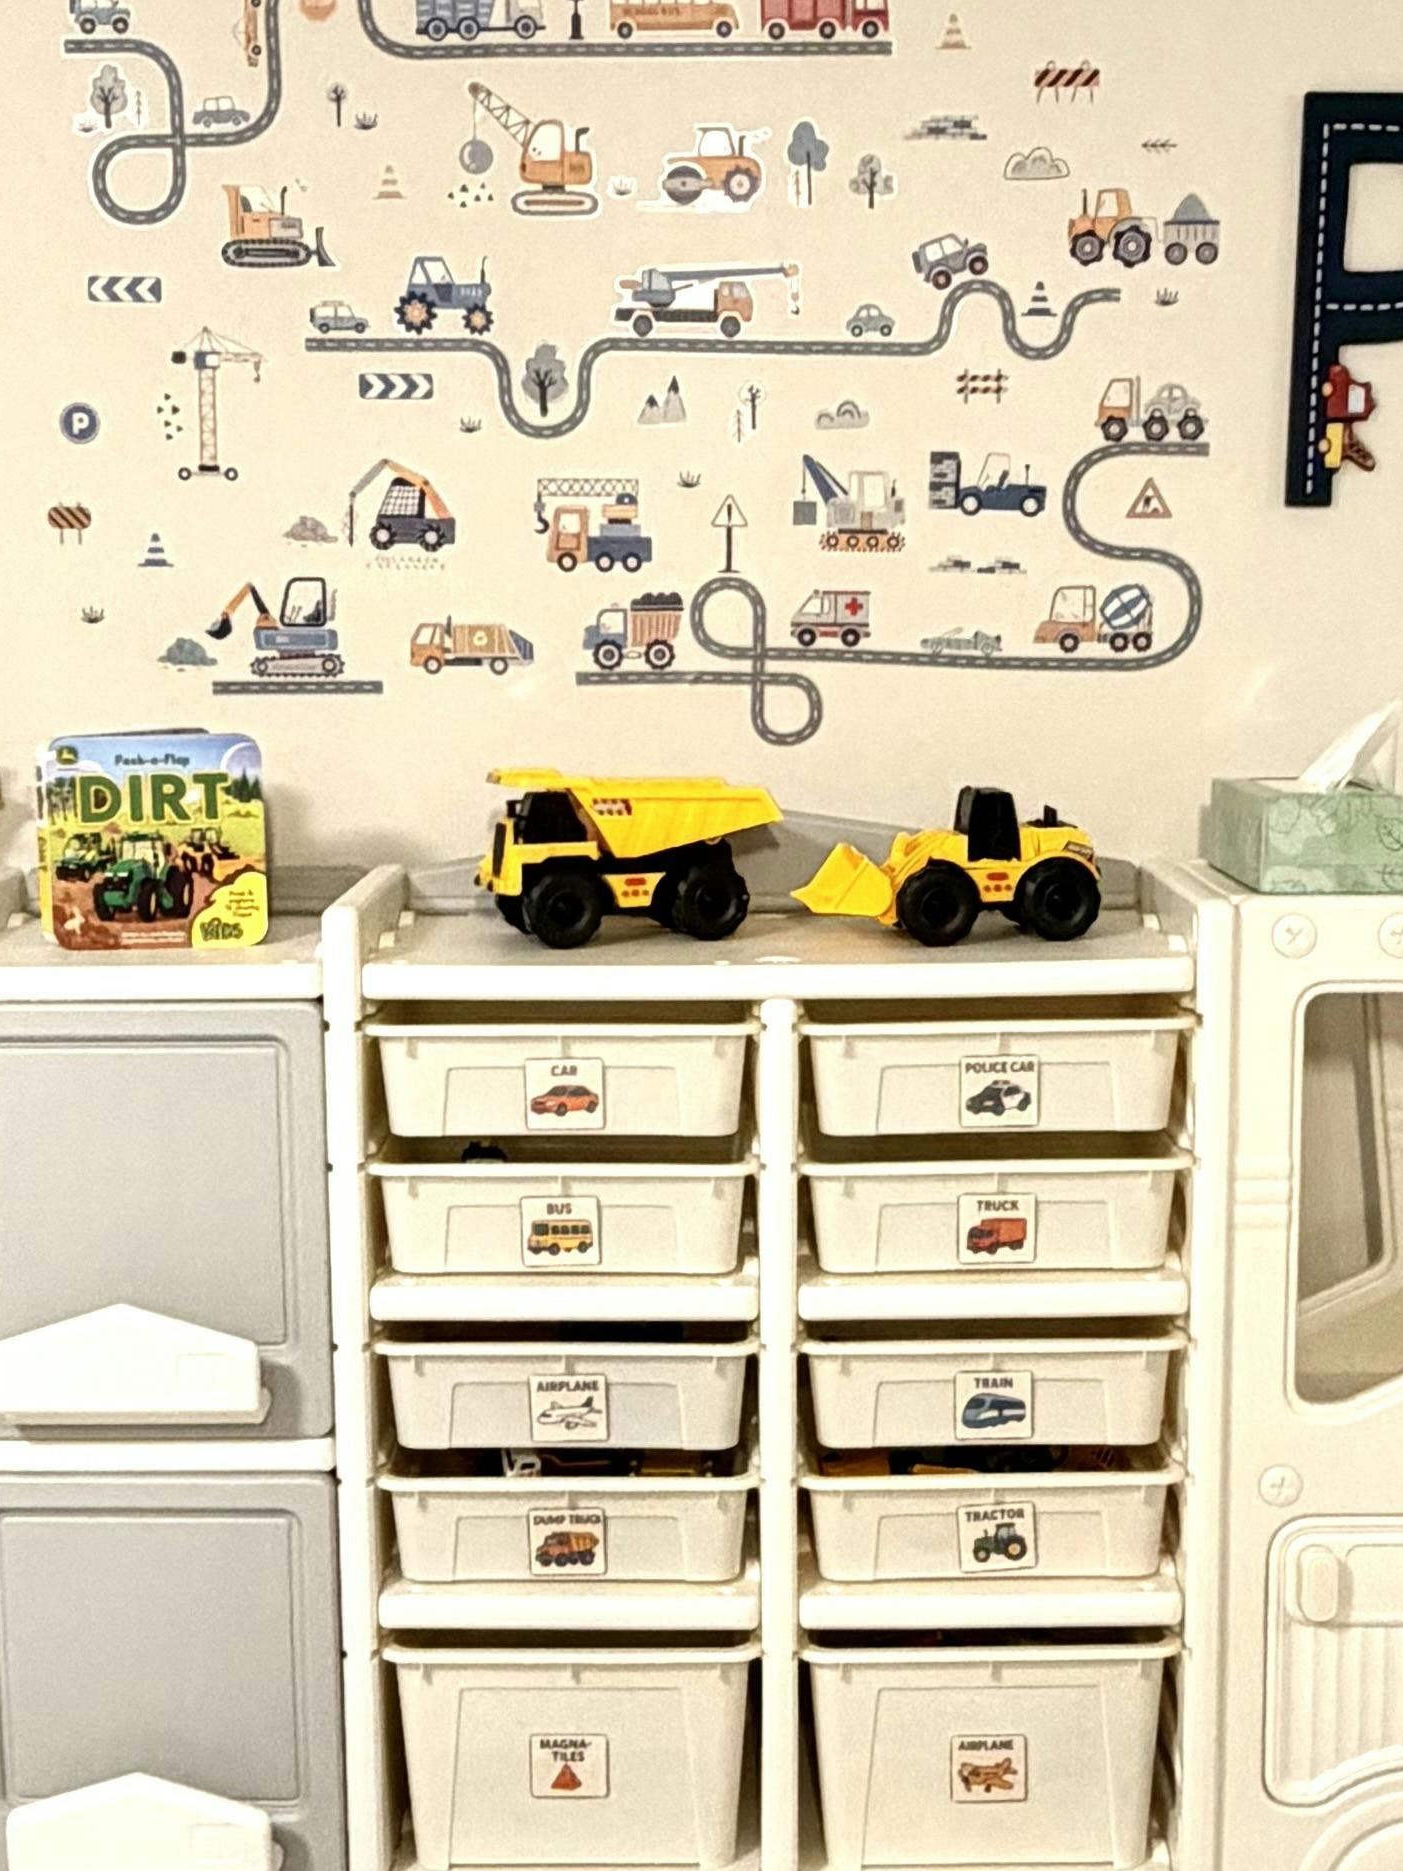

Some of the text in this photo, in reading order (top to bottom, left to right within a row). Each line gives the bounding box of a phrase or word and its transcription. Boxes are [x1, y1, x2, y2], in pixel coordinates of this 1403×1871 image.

[73, 413, 89, 435] P
[79, 772, 229, 823] DIRT
[550, 1065, 578, 1077] CAR
[965, 1061, 1035, 1074] POLICE CAR
[546, 1203, 572, 1215] BUS
[976, 1200, 1019, 1212] TRUCK
[536, 1380, 599, 1392] AIRPLANE
[973, 1377, 1014, 1389] TRAIN
[965, 1508, 1024, 1522] TRACTOR
[958, 1739, 1015, 1750] AIRPLANE
[552, 1751, 586, 1762] TILES
